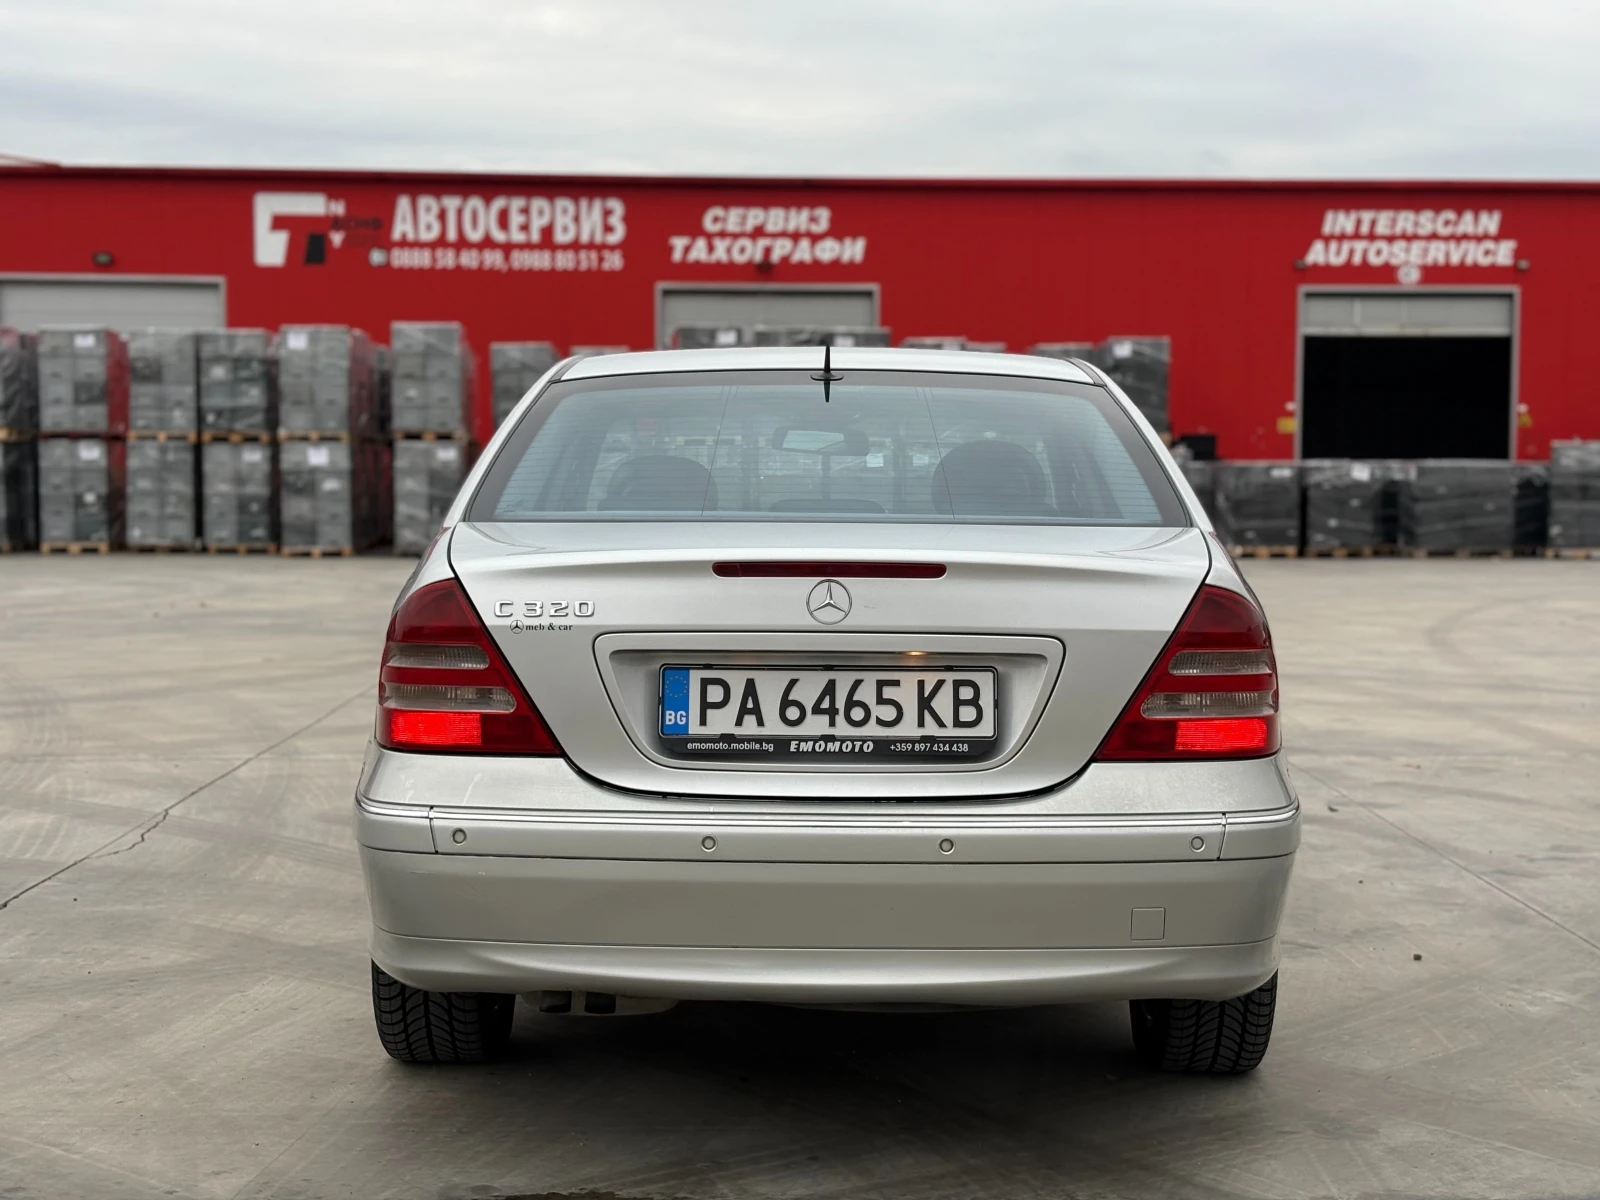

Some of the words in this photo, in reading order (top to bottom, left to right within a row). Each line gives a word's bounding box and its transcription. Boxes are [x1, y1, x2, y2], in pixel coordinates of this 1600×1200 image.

[391, 194, 627, 245] АВТОСЕРВИЗ
[702, 205, 832, 235] СЕРВИЗ
[1321, 209, 1502, 236] INTERSCAN
[668, 235, 867, 264] ТАХОГРАФИ
[1304, 238, 1518, 267] AUTOSERVICE
[494, 600, 514, 618] C
[523, 600, 595, 618] 320
[547, 622, 556, 631] &
[699, 677, 765, 727] PA
[779, 678, 904, 728] 6465
[917, 679, 984, 728] KB
[665, 711, 687, 725] BG
[687, 741, 774, 752] emomoto.mobile.bg
[789, 740, 874, 752] EMOMOTO
[890, 743, 912, 752] +359
[914, 743, 931, 752] 897
[933, 743, 950, 752] 434
[952, 743, 969, 752] 438
